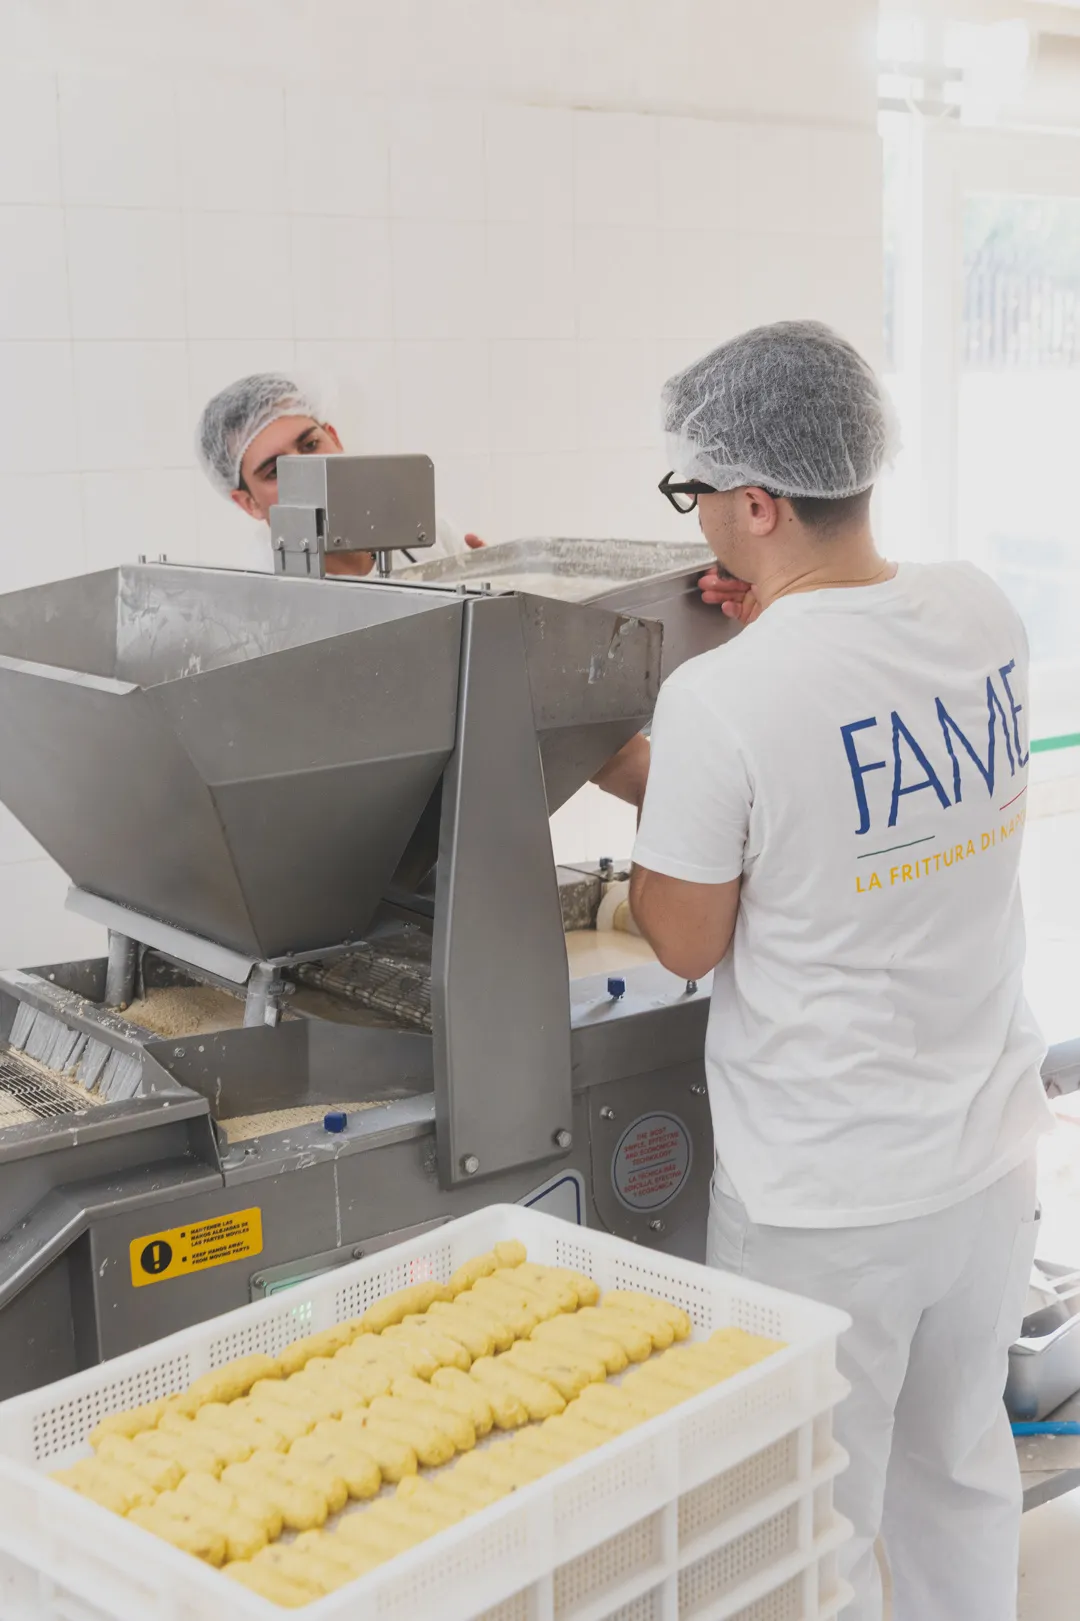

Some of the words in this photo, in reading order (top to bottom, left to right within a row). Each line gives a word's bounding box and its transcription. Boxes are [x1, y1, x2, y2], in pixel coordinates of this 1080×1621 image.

[840, 658, 1029, 835] FAME
[855, 872, 882, 893] LA
[889, 839, 975, 885] FRITTURA
[981, 828, 995, 850] DI
[636, 1132, 648, 1141] THE
[649, 1127, 666, 1136] MOST
[625, 1151, 638, 1160] AND
[640, 1141, 679, 1156] ECONOMICAL
[632, 1149, 672, 1166] TECHNOLOGY
[191, 1223, 221, 1234] MANTENER
[191, 1232, 211, 1241] MANOS
[212, 1224, 240, 1235] ALEJADAS
[203, 1234, 225, 1244] PARTES
[192, 1256, 208, 1265] FROM
[209, 1251, 231, 1260] MOVING
[232, 1245, 250, 1254] PARTS
[208, 1246, 227, 1255] HANDS
[228, 1241, 244, 1249] AWAY
